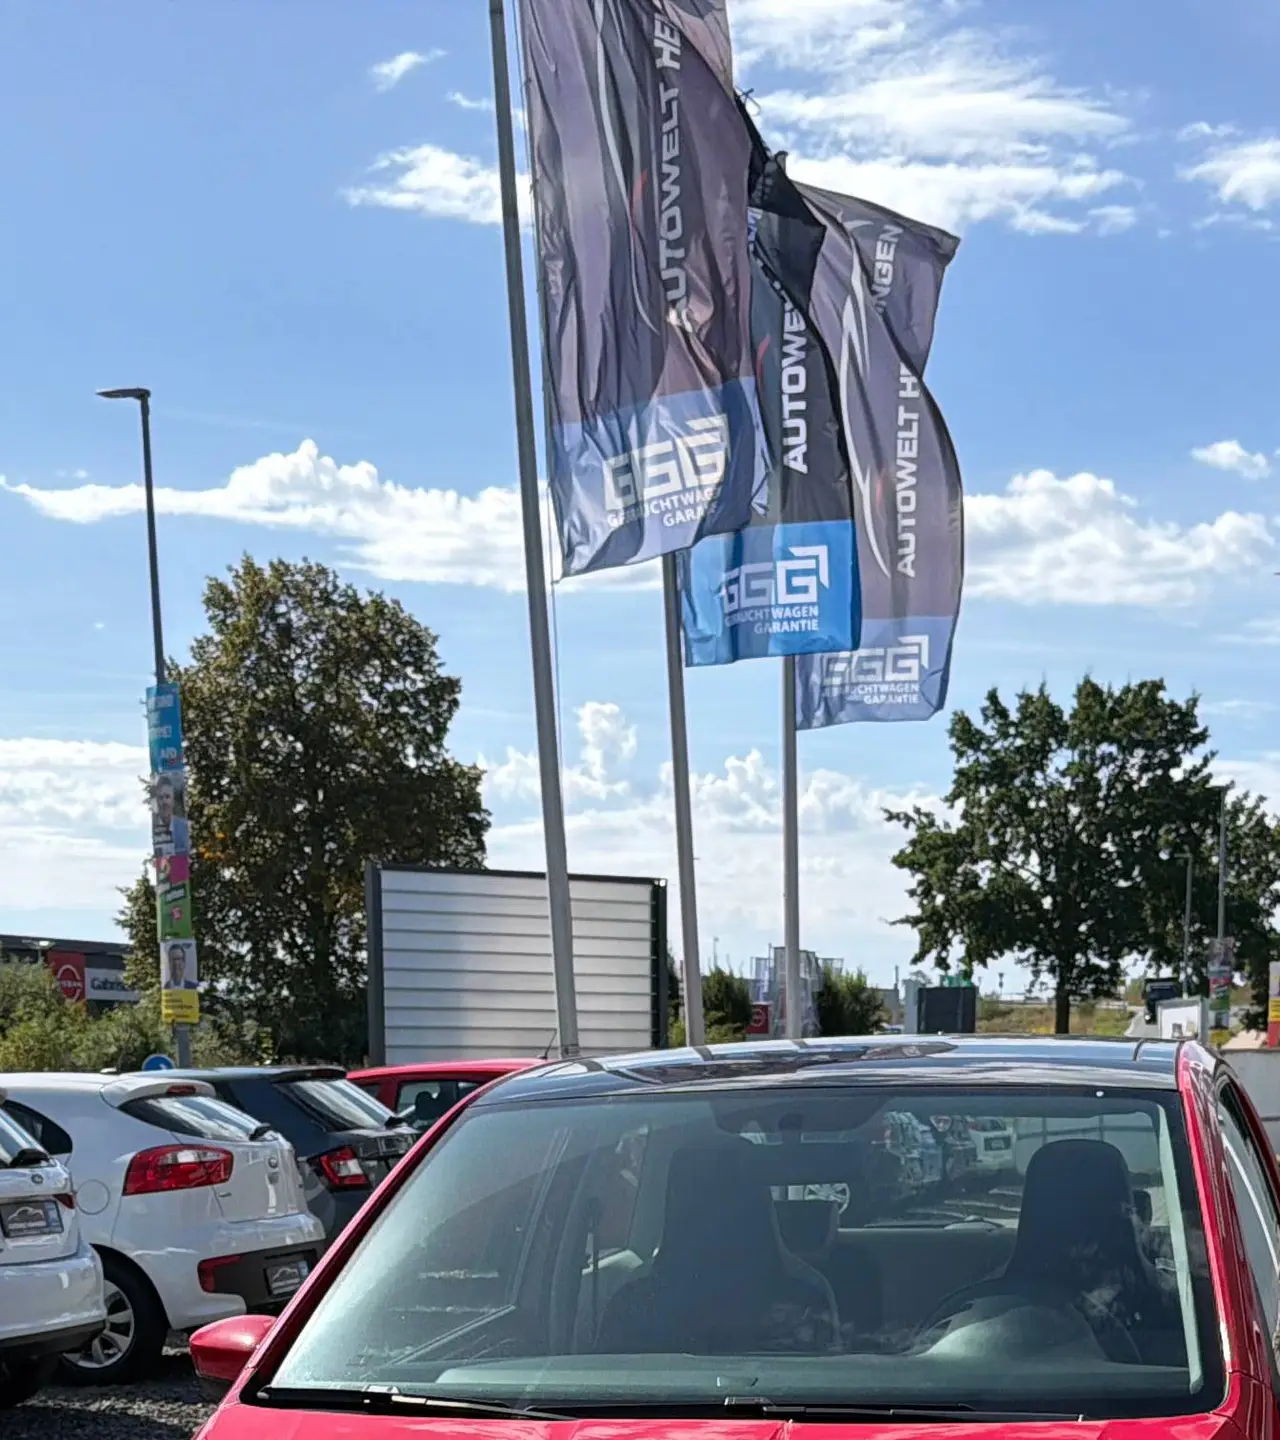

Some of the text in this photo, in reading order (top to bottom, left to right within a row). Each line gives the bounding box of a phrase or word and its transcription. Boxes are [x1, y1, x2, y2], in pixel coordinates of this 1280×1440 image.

[895, 406, 920, 578] AUTOWELT
[723, 559, 818, 614] GGG
[754, 619, 819, 634] GARANTIE
